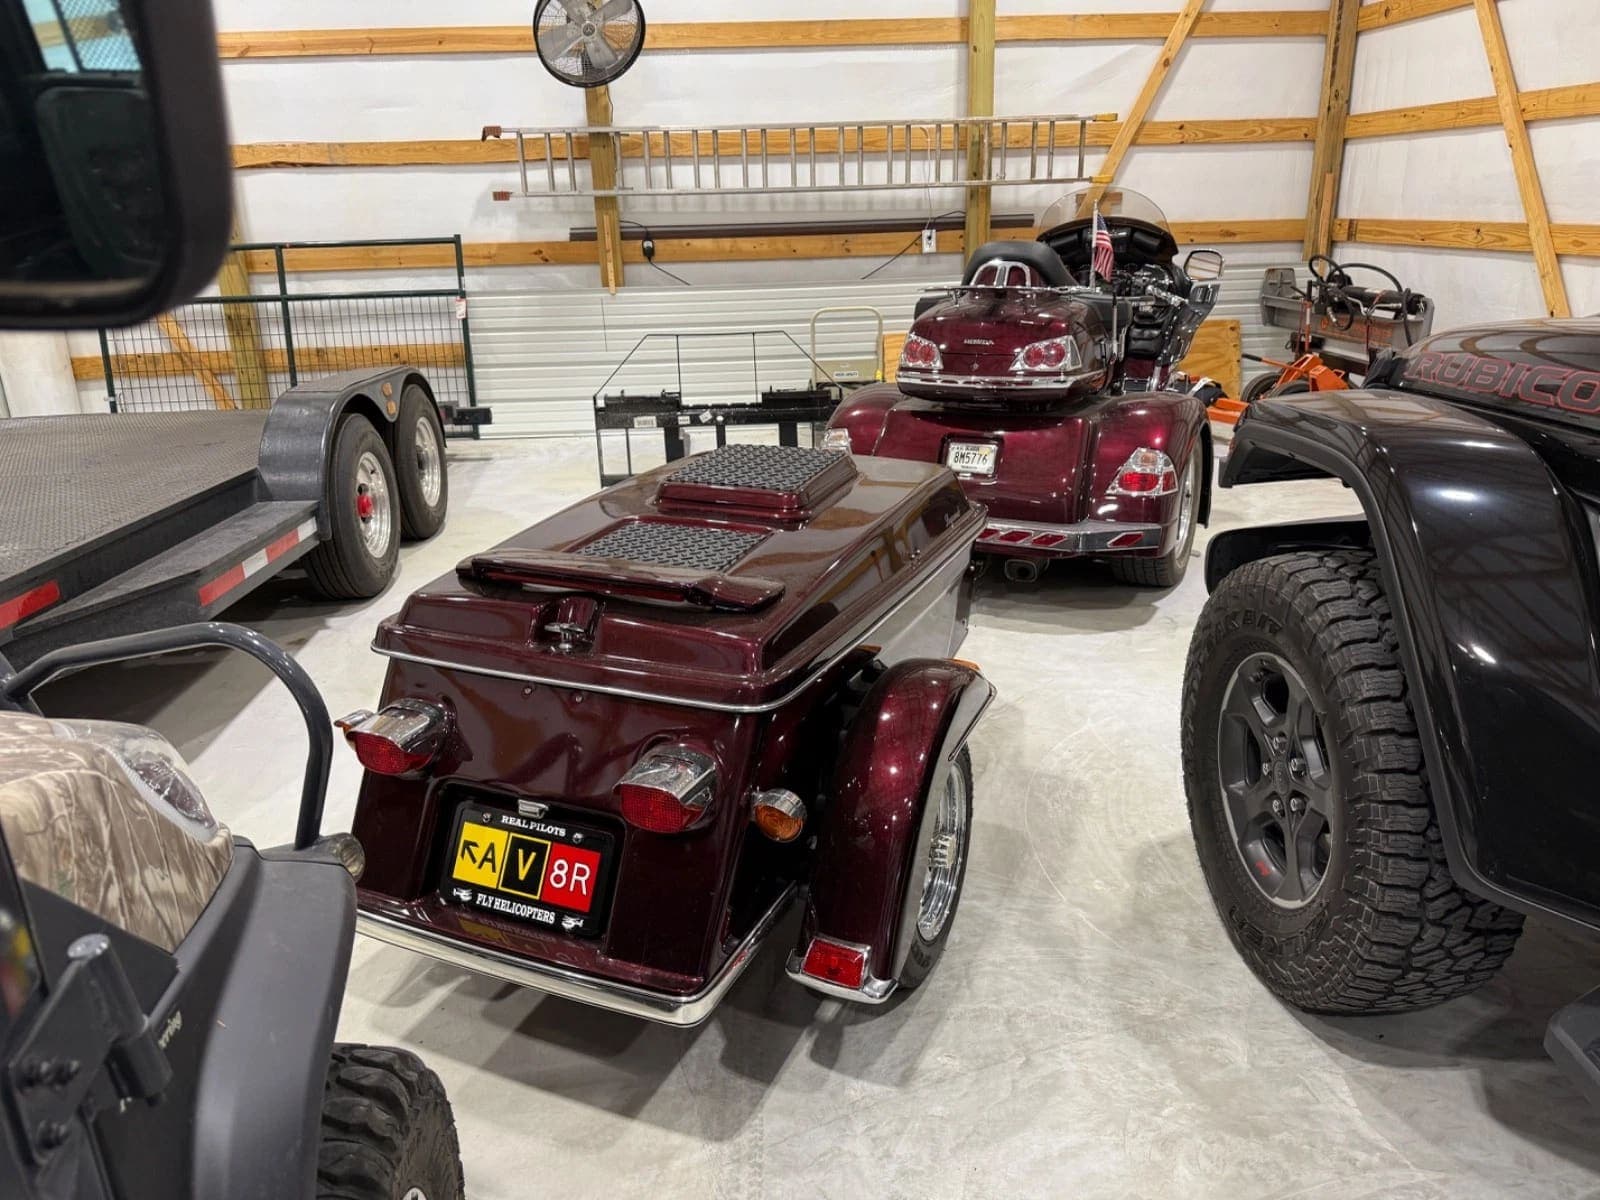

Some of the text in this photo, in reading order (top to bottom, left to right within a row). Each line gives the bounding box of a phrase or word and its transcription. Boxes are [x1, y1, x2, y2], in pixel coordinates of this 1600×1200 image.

[501, 815, 567, 838] REAL PILOTS
[477, 842, 591, 896] A V 8R
[476, 893, 556, 925] FLY HELICOPTERS
